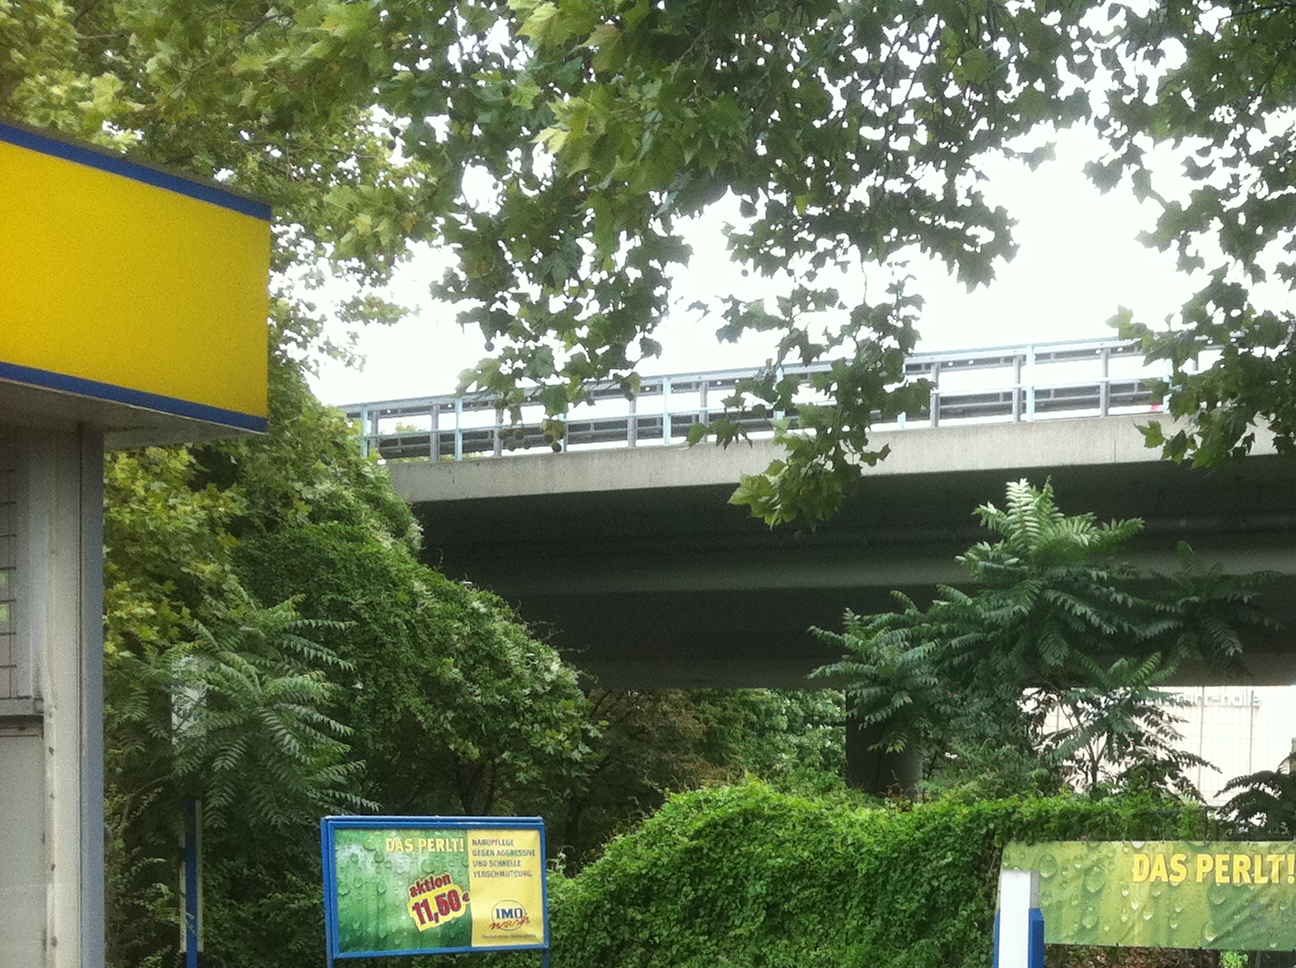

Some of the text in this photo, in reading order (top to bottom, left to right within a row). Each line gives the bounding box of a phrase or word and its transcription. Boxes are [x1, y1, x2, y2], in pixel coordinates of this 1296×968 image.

[386, 837, 464, 853] DAS PERLT!
[1132, 853, 1296, 884] DAS PERLT!
[409, 874, 451, 897] aktion
[412, 889, 461, 925] 11,50
[496, 908, 524, 919] IMO
